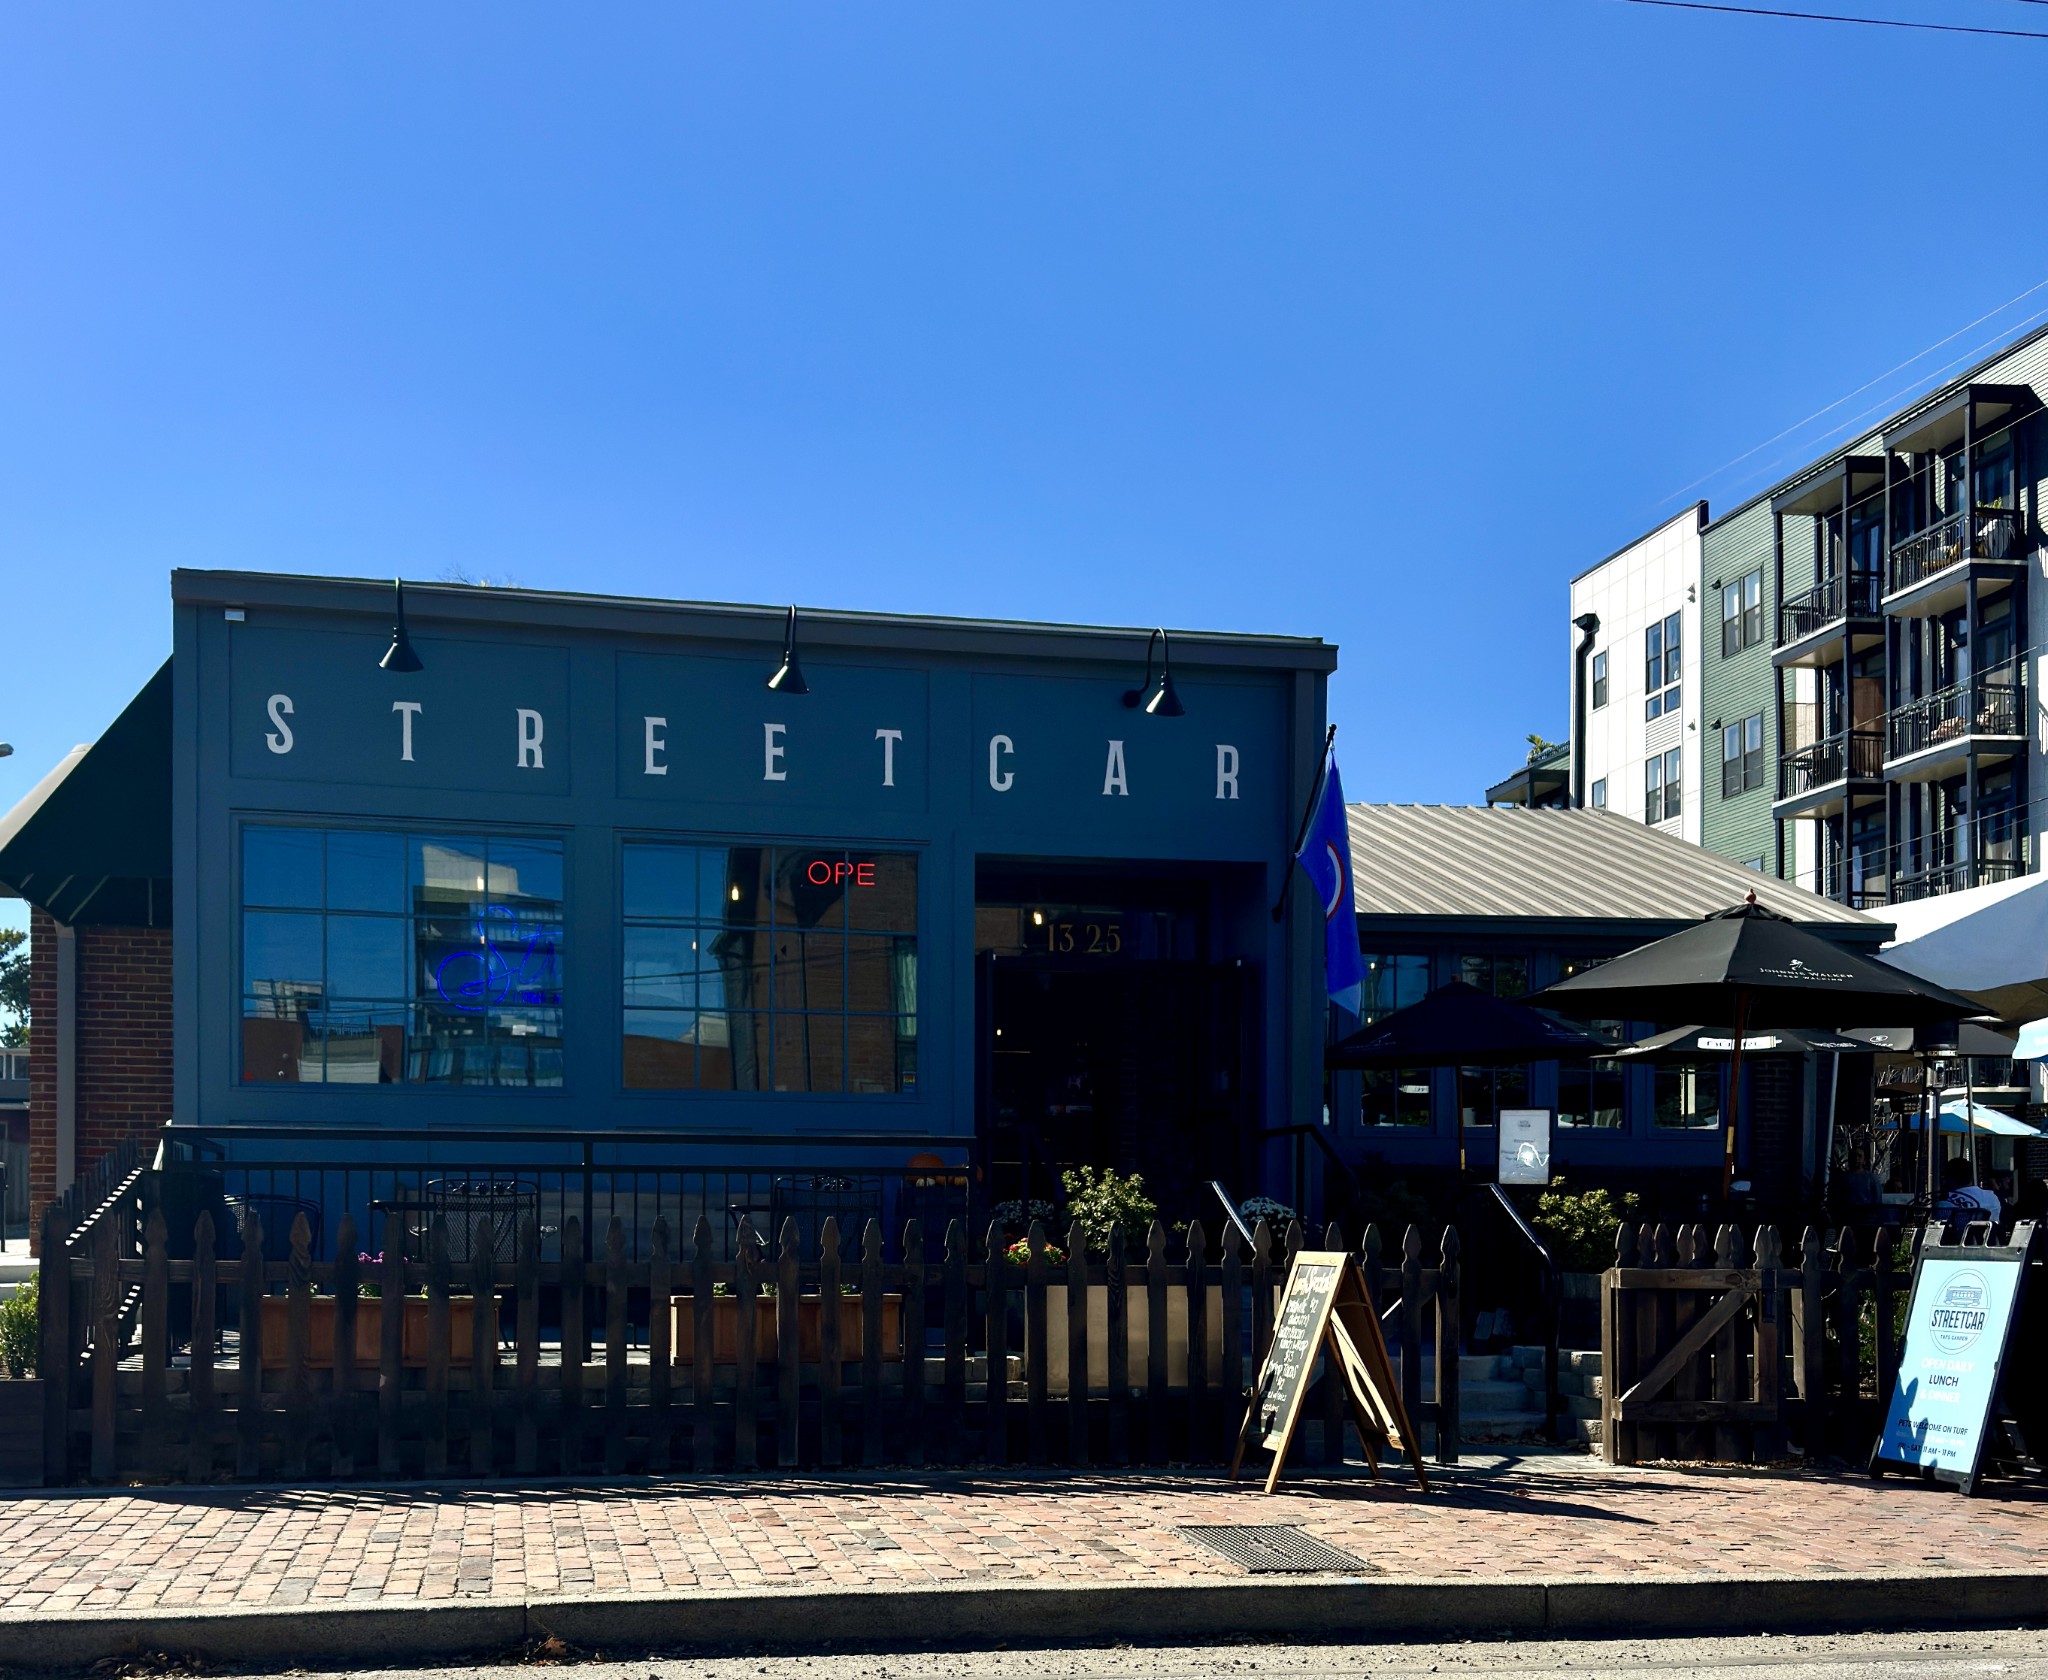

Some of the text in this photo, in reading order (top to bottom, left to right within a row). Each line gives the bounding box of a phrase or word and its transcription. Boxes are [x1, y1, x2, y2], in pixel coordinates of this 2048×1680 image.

[264, 694, 1241, 800] STREETCAR
[1931, 1310, 1985, 1330] STREETCAR
[1921, 1357, 1975, 1373] OPEN DAILY
[1928, 1374, 1959, 1387] LUNCH
[1928, 1390, 1961, 1403] DINNER
[1913, 1421, 1942, 1431] WELCOME
[1953, 1426, 1968, 1436] TURF
[1947, 1449, 1957, 1458] PM
